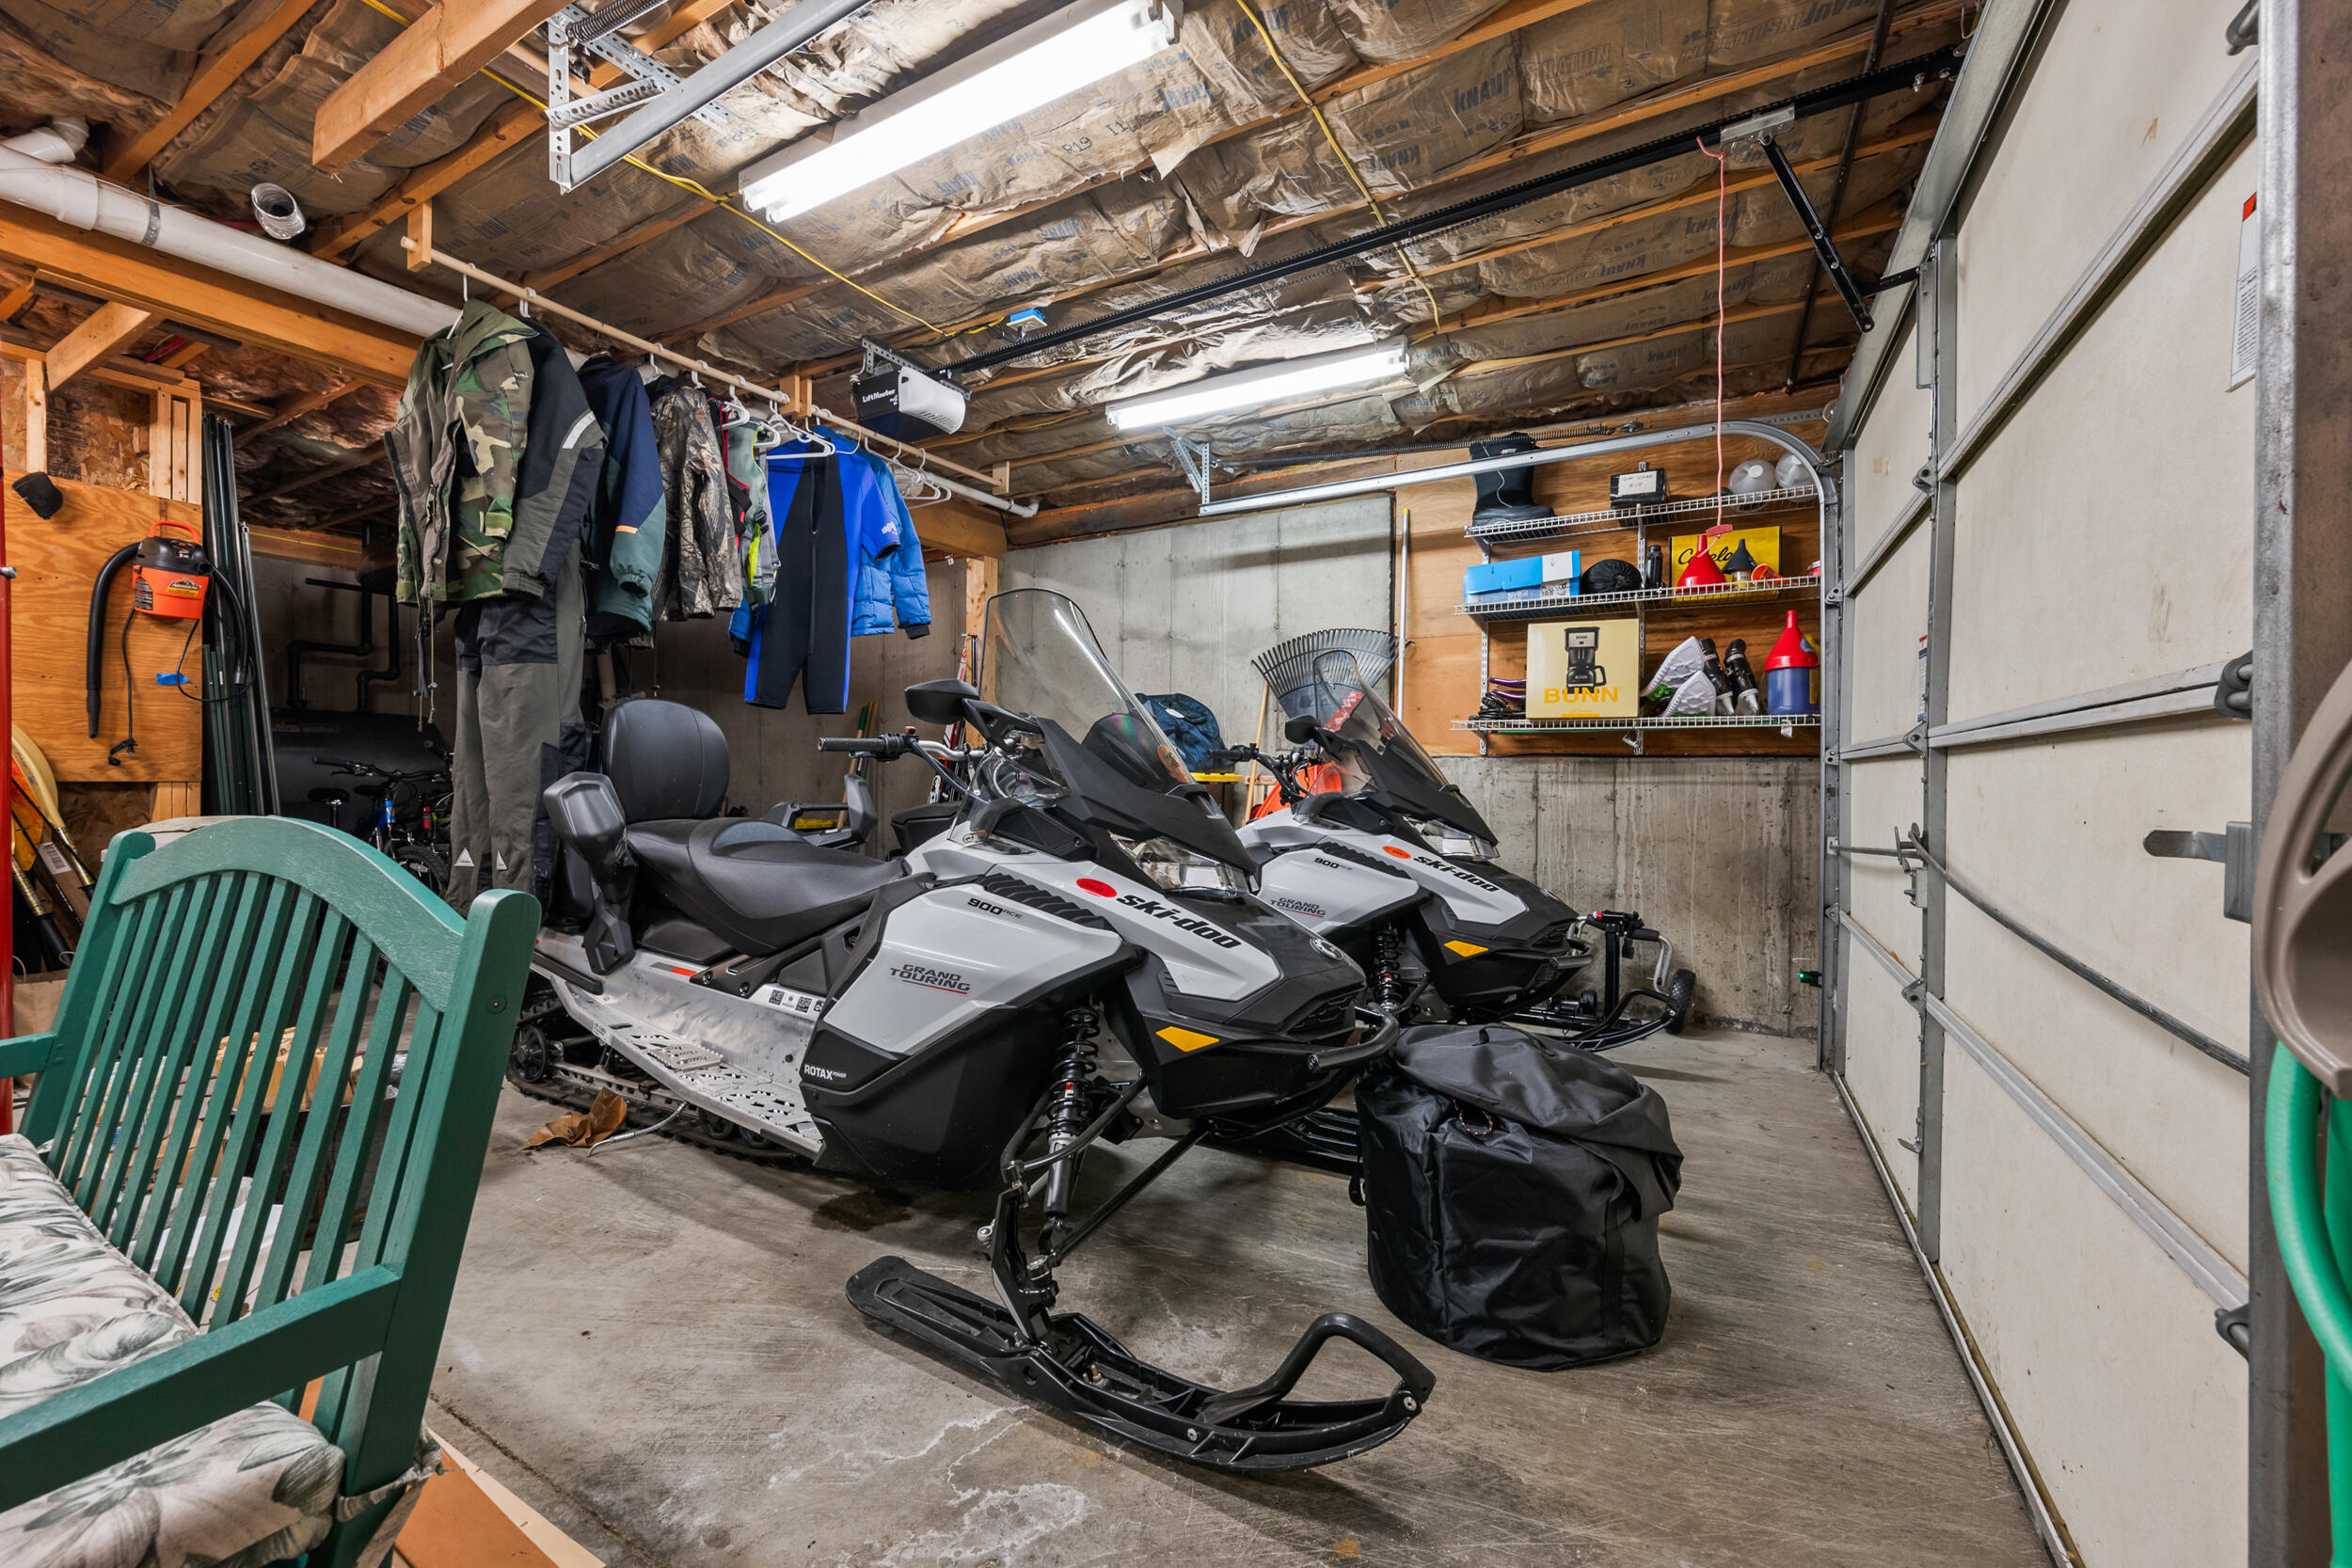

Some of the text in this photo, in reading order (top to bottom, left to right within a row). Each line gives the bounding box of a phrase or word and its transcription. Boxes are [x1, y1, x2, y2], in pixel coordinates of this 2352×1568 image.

[1454, 68, 1512, 115] KNAUF
[1061, 137, 1092, 155] R19
[1370, 144, 1422, 174] KNAUF
[1599, 253, 1646, 277] KNAUF
[862, 388, 896, 404] LiftMaster
[1544, 687, 1619, 704] BUNN
[1314, 857, 1340, 869] 900
[967, 897, 1005, 915] 900
[1270, 899, 1326, 915] TOURING
[1279, 897, 1319, 910] GRAND
[890, 968, 971, 991] TOURING
[902, 964, 961, 981] GRAND
[804, 1064, 834, 1081] ROTAX
